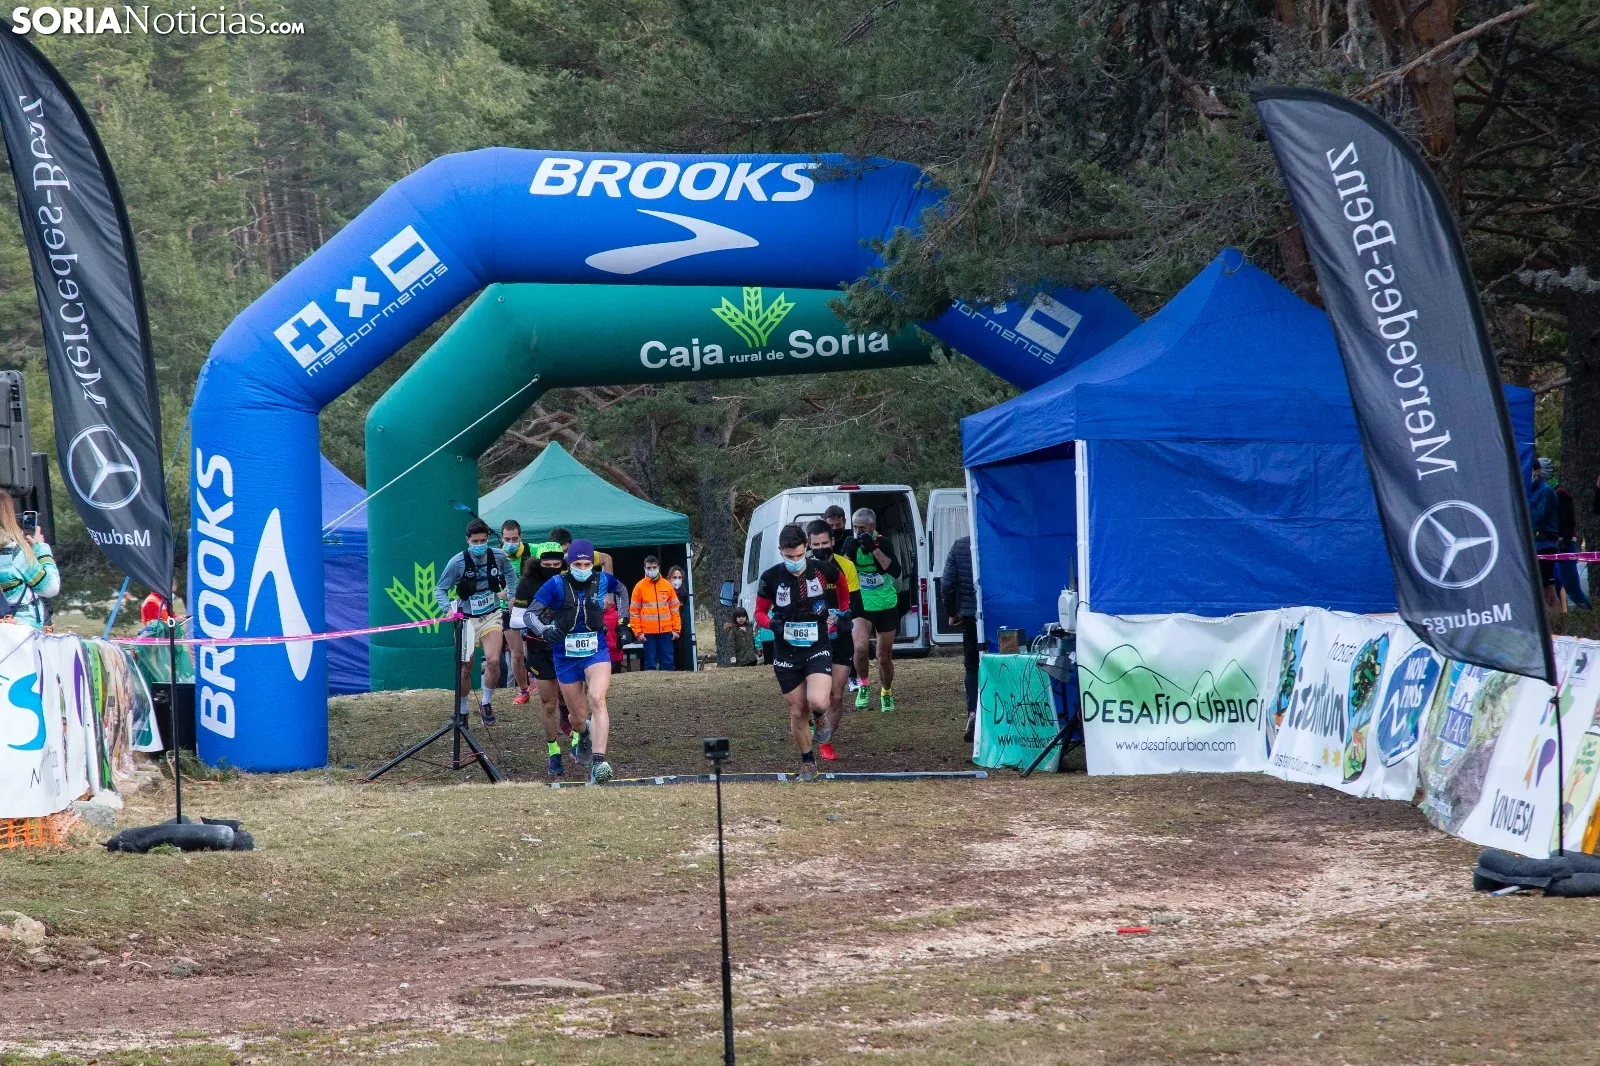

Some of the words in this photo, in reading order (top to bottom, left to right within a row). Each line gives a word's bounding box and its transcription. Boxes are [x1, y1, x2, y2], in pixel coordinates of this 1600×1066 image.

[529, 156, 817, 202] BROOKS
[306, 262, 449, 377] maspormenos
[639, 337, 724, 371] Caja
[728, 350, 762, 363] rural
[765, 349, 785, 361] de
[788, 329, 890, 359] Soria
[196, 447, 236, 739] BROOKS
[575, 638, 590, 649] 067
[793, 628, 809, 638] 063
[1115, 736, 1237, 752] www.desafiourbion.com
[1489, 788, 1536, 843] VINUESA
